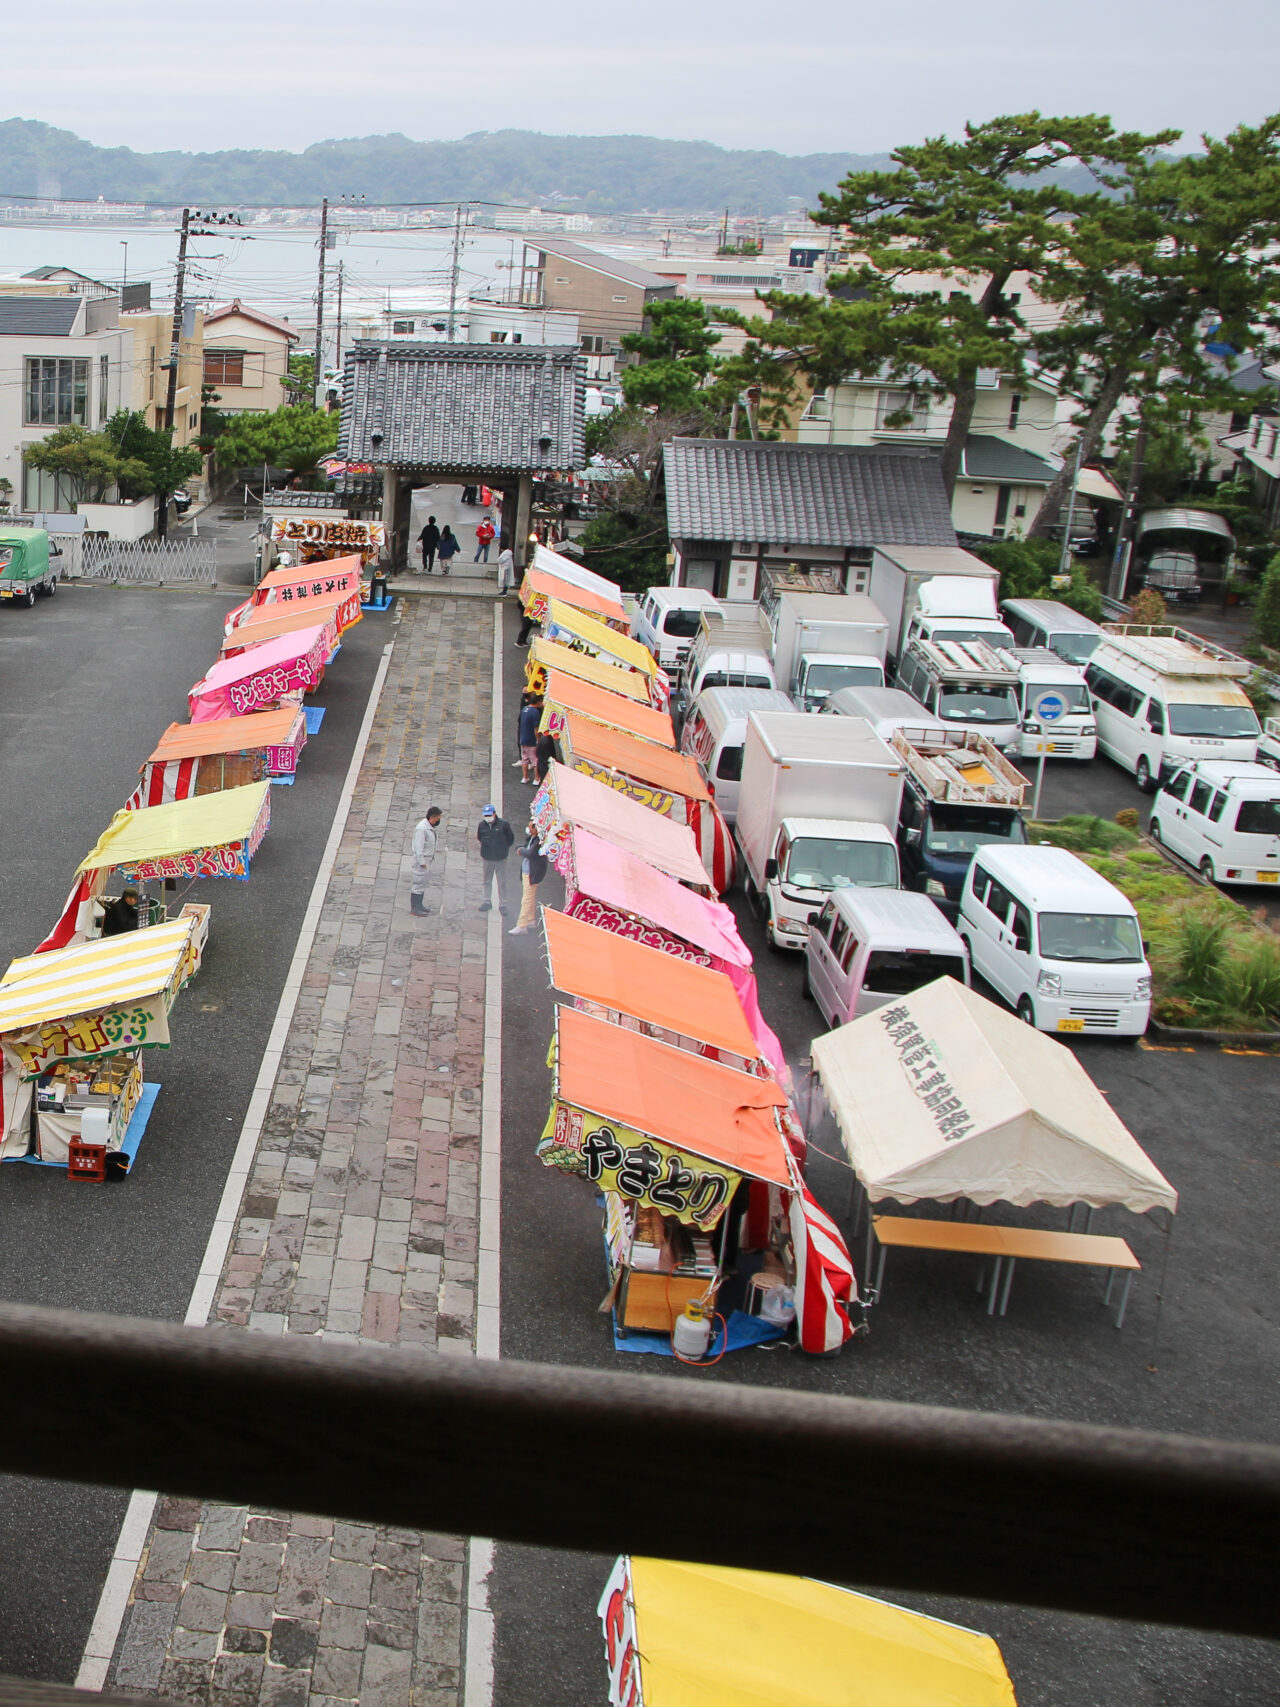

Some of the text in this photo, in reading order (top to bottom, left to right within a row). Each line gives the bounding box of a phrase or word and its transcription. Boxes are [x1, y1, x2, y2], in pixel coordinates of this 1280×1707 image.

[230, 658, 313, 713] タン塩ステーキ
[136, 849, 239, 879] 金魚すくい
[581, 1127, 728, 1224] やきとり
